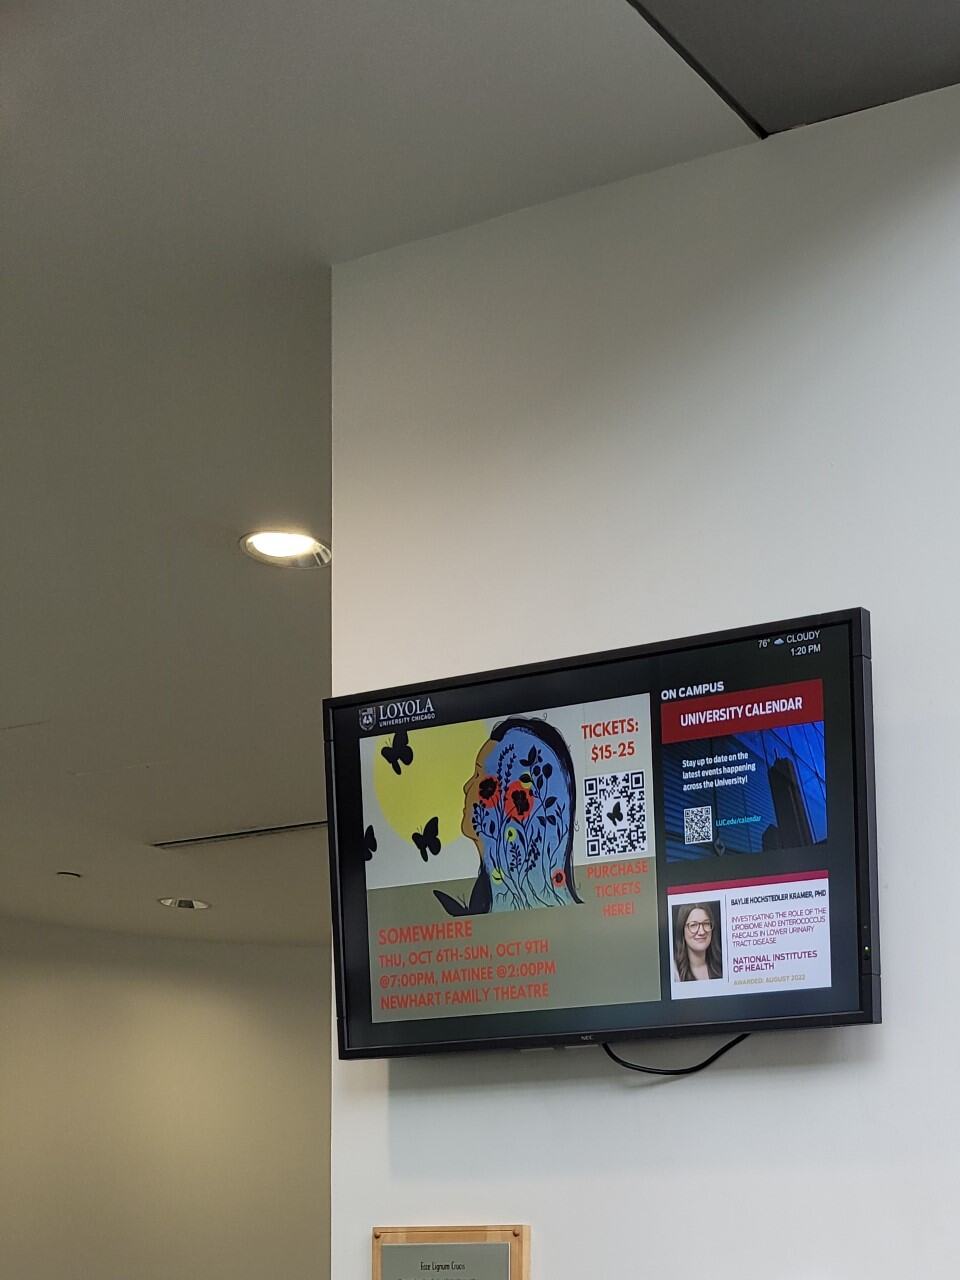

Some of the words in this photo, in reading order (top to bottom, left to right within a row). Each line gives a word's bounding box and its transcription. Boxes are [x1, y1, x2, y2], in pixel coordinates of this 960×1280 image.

[786, 630, 821, 644] CLOUDY
[790, 646, 807, 656] 1:20
[807, 644, 821, 654] PM
[661, 689, 677, 700] ON
[678, 681, 725, 698] CAMPUS
[379, 697, 435, 720] LOYOLA
[680, 705, 744, 727] UNIVERSITY
[745, 696, 803, 717] CALENDAR
[379, 717, 411, 728] UNIVERSITY
[411, 713, 436, 722] CHICAGO
[581, 718, 639, 739] TICKETS:
[591, 741, 635, 763] $15-25
[682, 759, 696, 768] Stay
[706, 757, 713, 765] to
[713, 755, 728, 764] date
[737, 752, 749, 760] the
[682, 770, 701, 779] latest
[701, 768, 722, 777] events
[722, 762, 756, 775] happening
[683, 782, 702, 792] across
[703, 780, 714, 788] the
[587, 861, 648, 879] PURCHASE
[595, 881, 641, 898] TICKETS
[731, 897, 749, 906] BAYLIE
[814, 889, 827, 898] PHD
[603, 901, 635, 917] HERE!
[732, 912, 774, 923] INVESTIGATING
[788, 909, 804, 917] ROLE
[378, 920, 473, 945] SOMEWHERE
[766, 928, 788, 936] LOWER
[789, 926, 815, 934] URINARY
[732, 940, 751, 948] TRACT
[752, 937, 777, 945] DISEASE
[378, 953, 405, 969] THU,
[408, 950, 432, 966] OCT
[436, 945, 493, 963] 6TH-SUN,
[496, 942, 522, 958] OCT
[524, 939, 549, 954] 9TH
[733, 955, 770, 965] NATIONAL
[773, 950, 817, 961] INSTITUTES
[379, 972, 438, 990] @7:00PM,
[441, 966, 493, 984] MATINEE
[496, 960, 556, 978] @2:00PM
[733, 965, 743, 973] OF
[745, 963, 775, 972] HEALTH
[380, 991, 441, 1010] NEWHART
[445, 987, 489, 1005] FAMILY
[493, 983, 549, 1000] THEATRE
